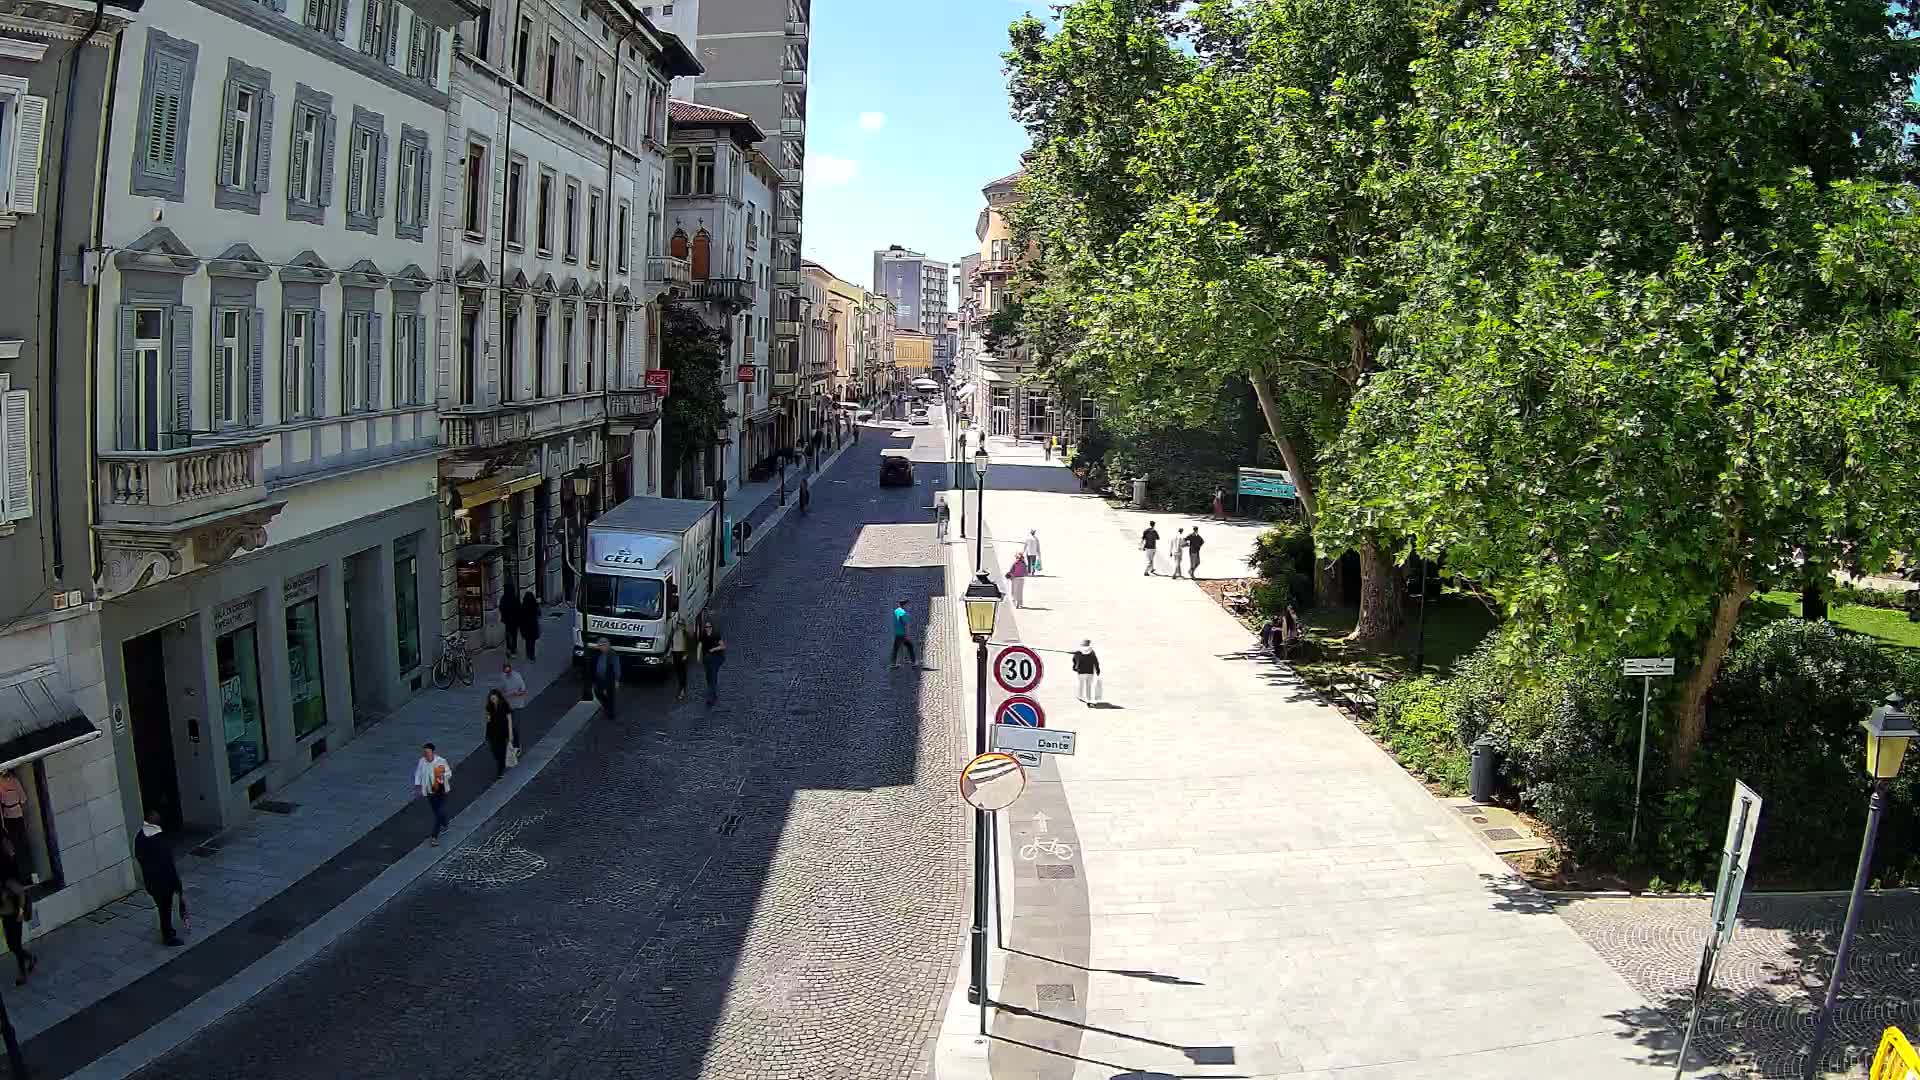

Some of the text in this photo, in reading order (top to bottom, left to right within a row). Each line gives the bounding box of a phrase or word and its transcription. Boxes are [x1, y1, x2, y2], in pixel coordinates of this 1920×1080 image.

[592, 619, 644, 632] TRASLOCHI
[1004, 659, 1032, 681] 30
[1038, 739, 1069, 750] Dante
